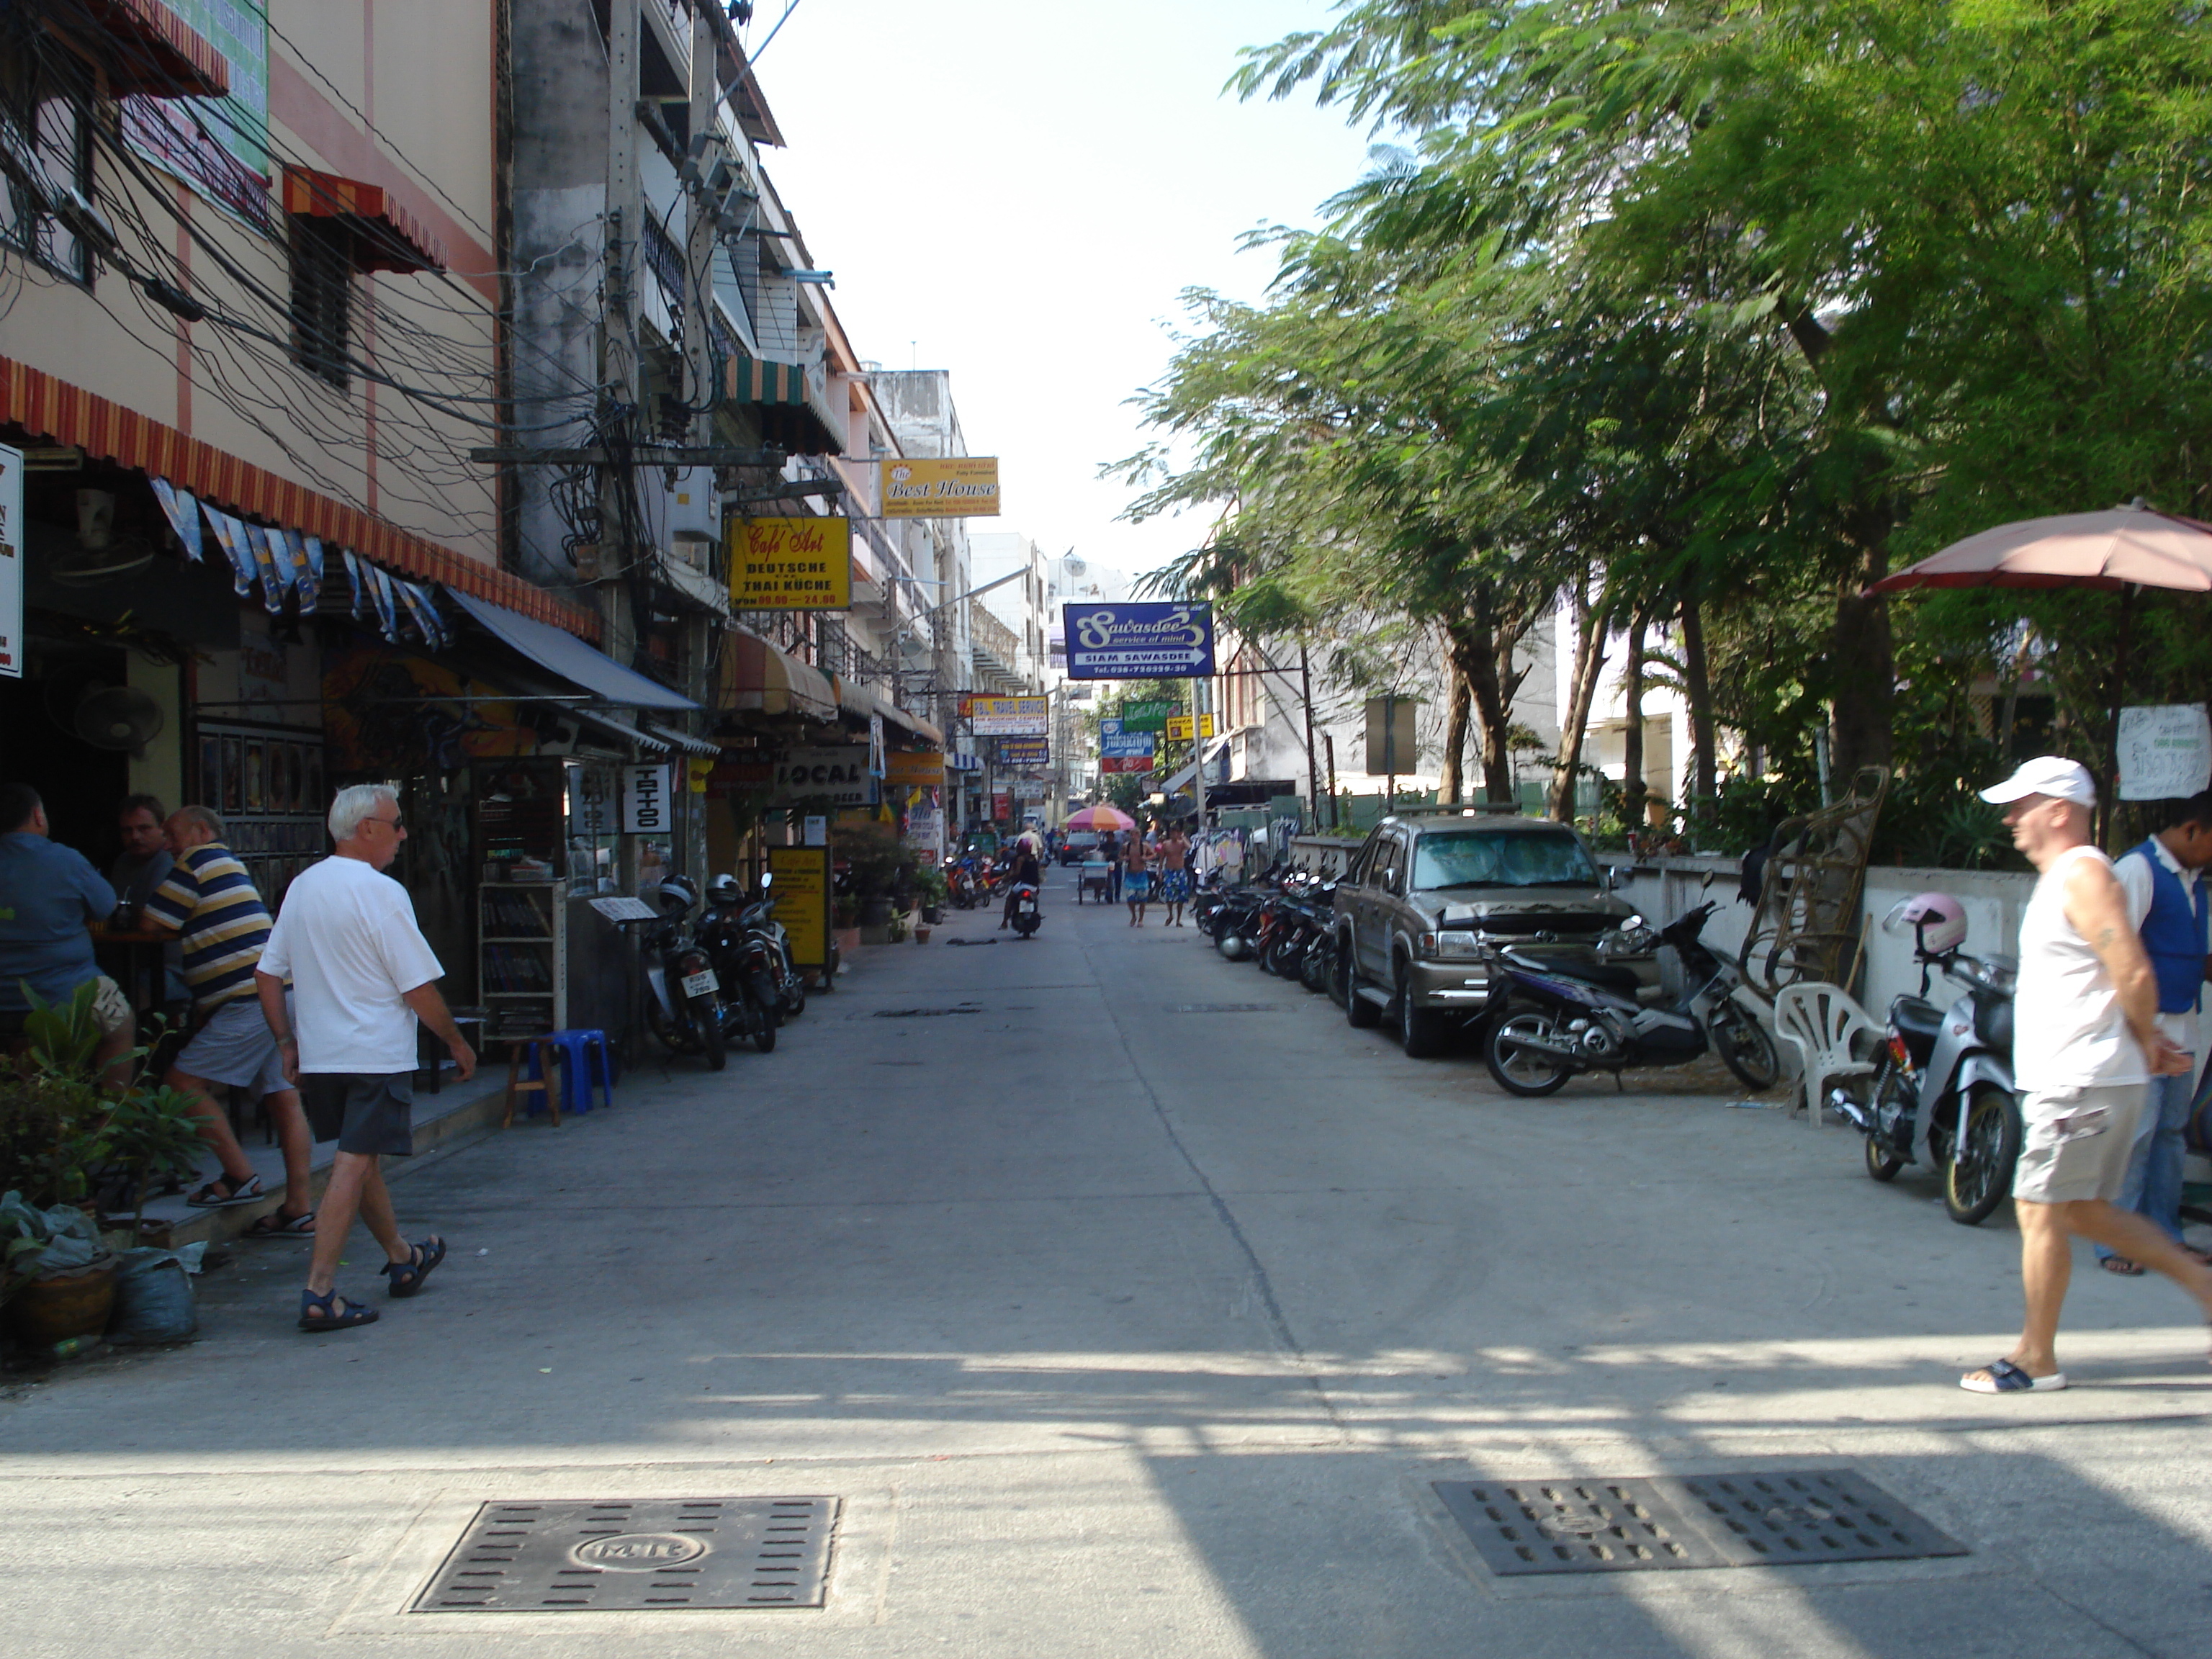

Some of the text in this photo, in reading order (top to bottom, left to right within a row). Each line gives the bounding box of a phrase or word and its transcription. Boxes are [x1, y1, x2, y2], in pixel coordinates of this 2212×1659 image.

[895, 467, 909, 479] The
[886, 478, 997, 499] Best House
[747, 525, 825, 562] Café Art
[747, 562, 827, 574] DEUTSCHE
[743, 578, 832, 592] THAI KÜCHE
[1076, 611, 1205, 649] Sawasdee
[1112, 634, 1146, 643] service
[1161, 633, 1185, 642] mind
[1085, 652, 1191, 663] SIAM SAWASDEE
[993, 700, 1017, 714] TRAVEL
[1018, 699, 1045, 714] SERVICE
[777, 763, 861, 786] LOCAL
[833, 793, 863, 802] BEER
